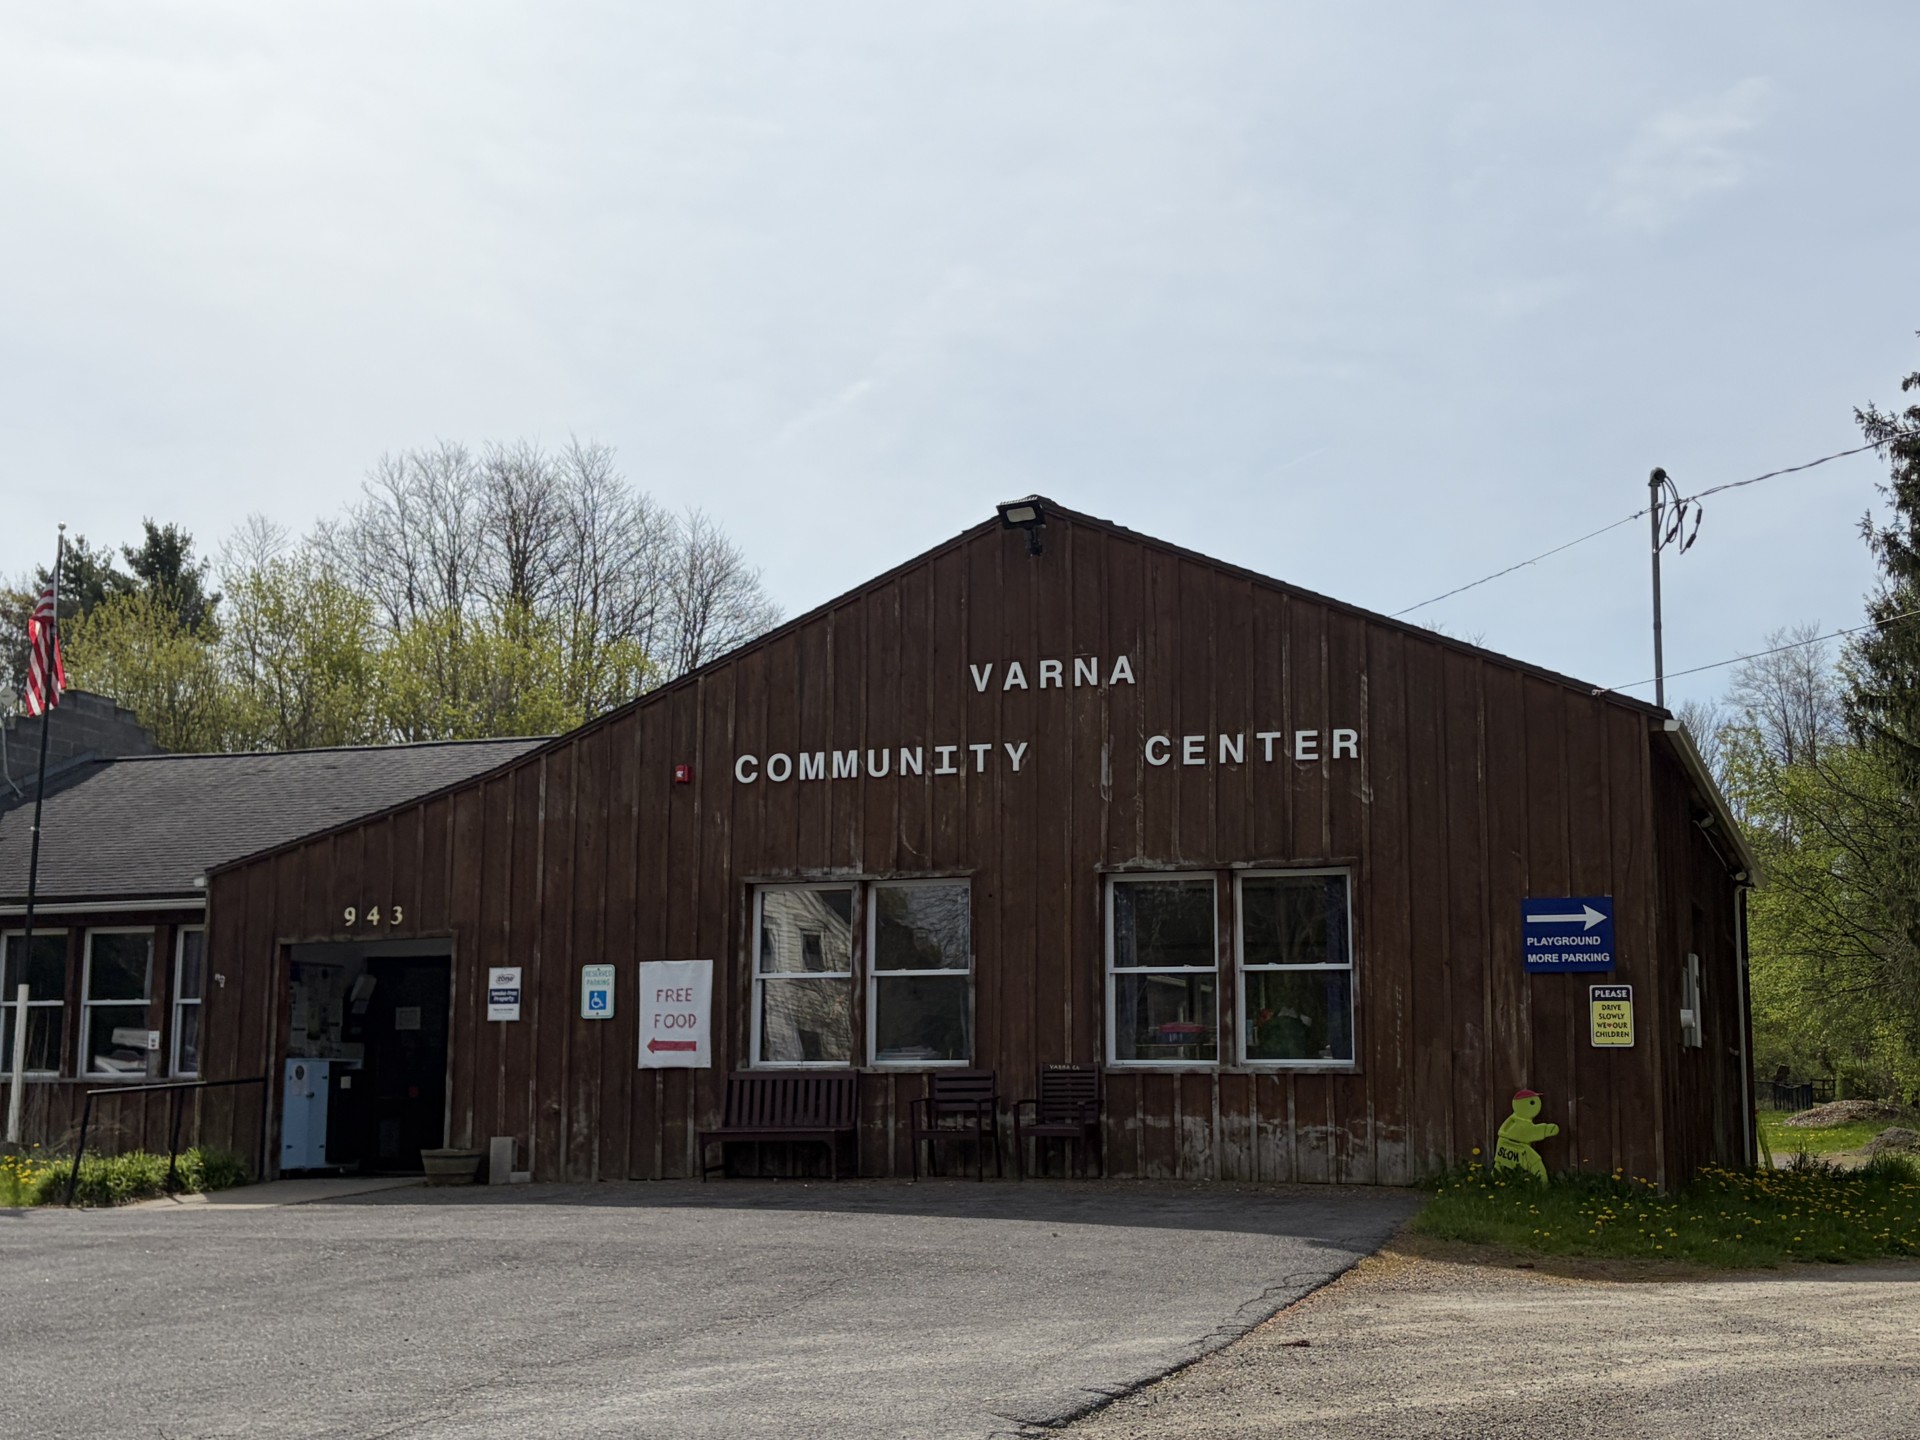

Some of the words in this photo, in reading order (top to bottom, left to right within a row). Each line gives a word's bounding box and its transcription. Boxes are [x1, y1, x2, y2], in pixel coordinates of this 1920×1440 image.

[969, 655, 1137, 693] VARNA
[733, 741, 1029, 784] COMMUNITY
[1144, 728, 1360, 767] CENTER
[343, 906, 404, 927] 943
[1527, 936, 1601, 946] PLAYGROUND
[1528, 954, 1559, 963] MORE
[1562, 953, 1610, 962] PARKING
[656, 988, 693, 1002] FREE
[1595, 990, 1628, 998] PLEASE
[654, 1013, 697, 1029] FOOD
[1498, 1147, 1519, 1162] SLOW
